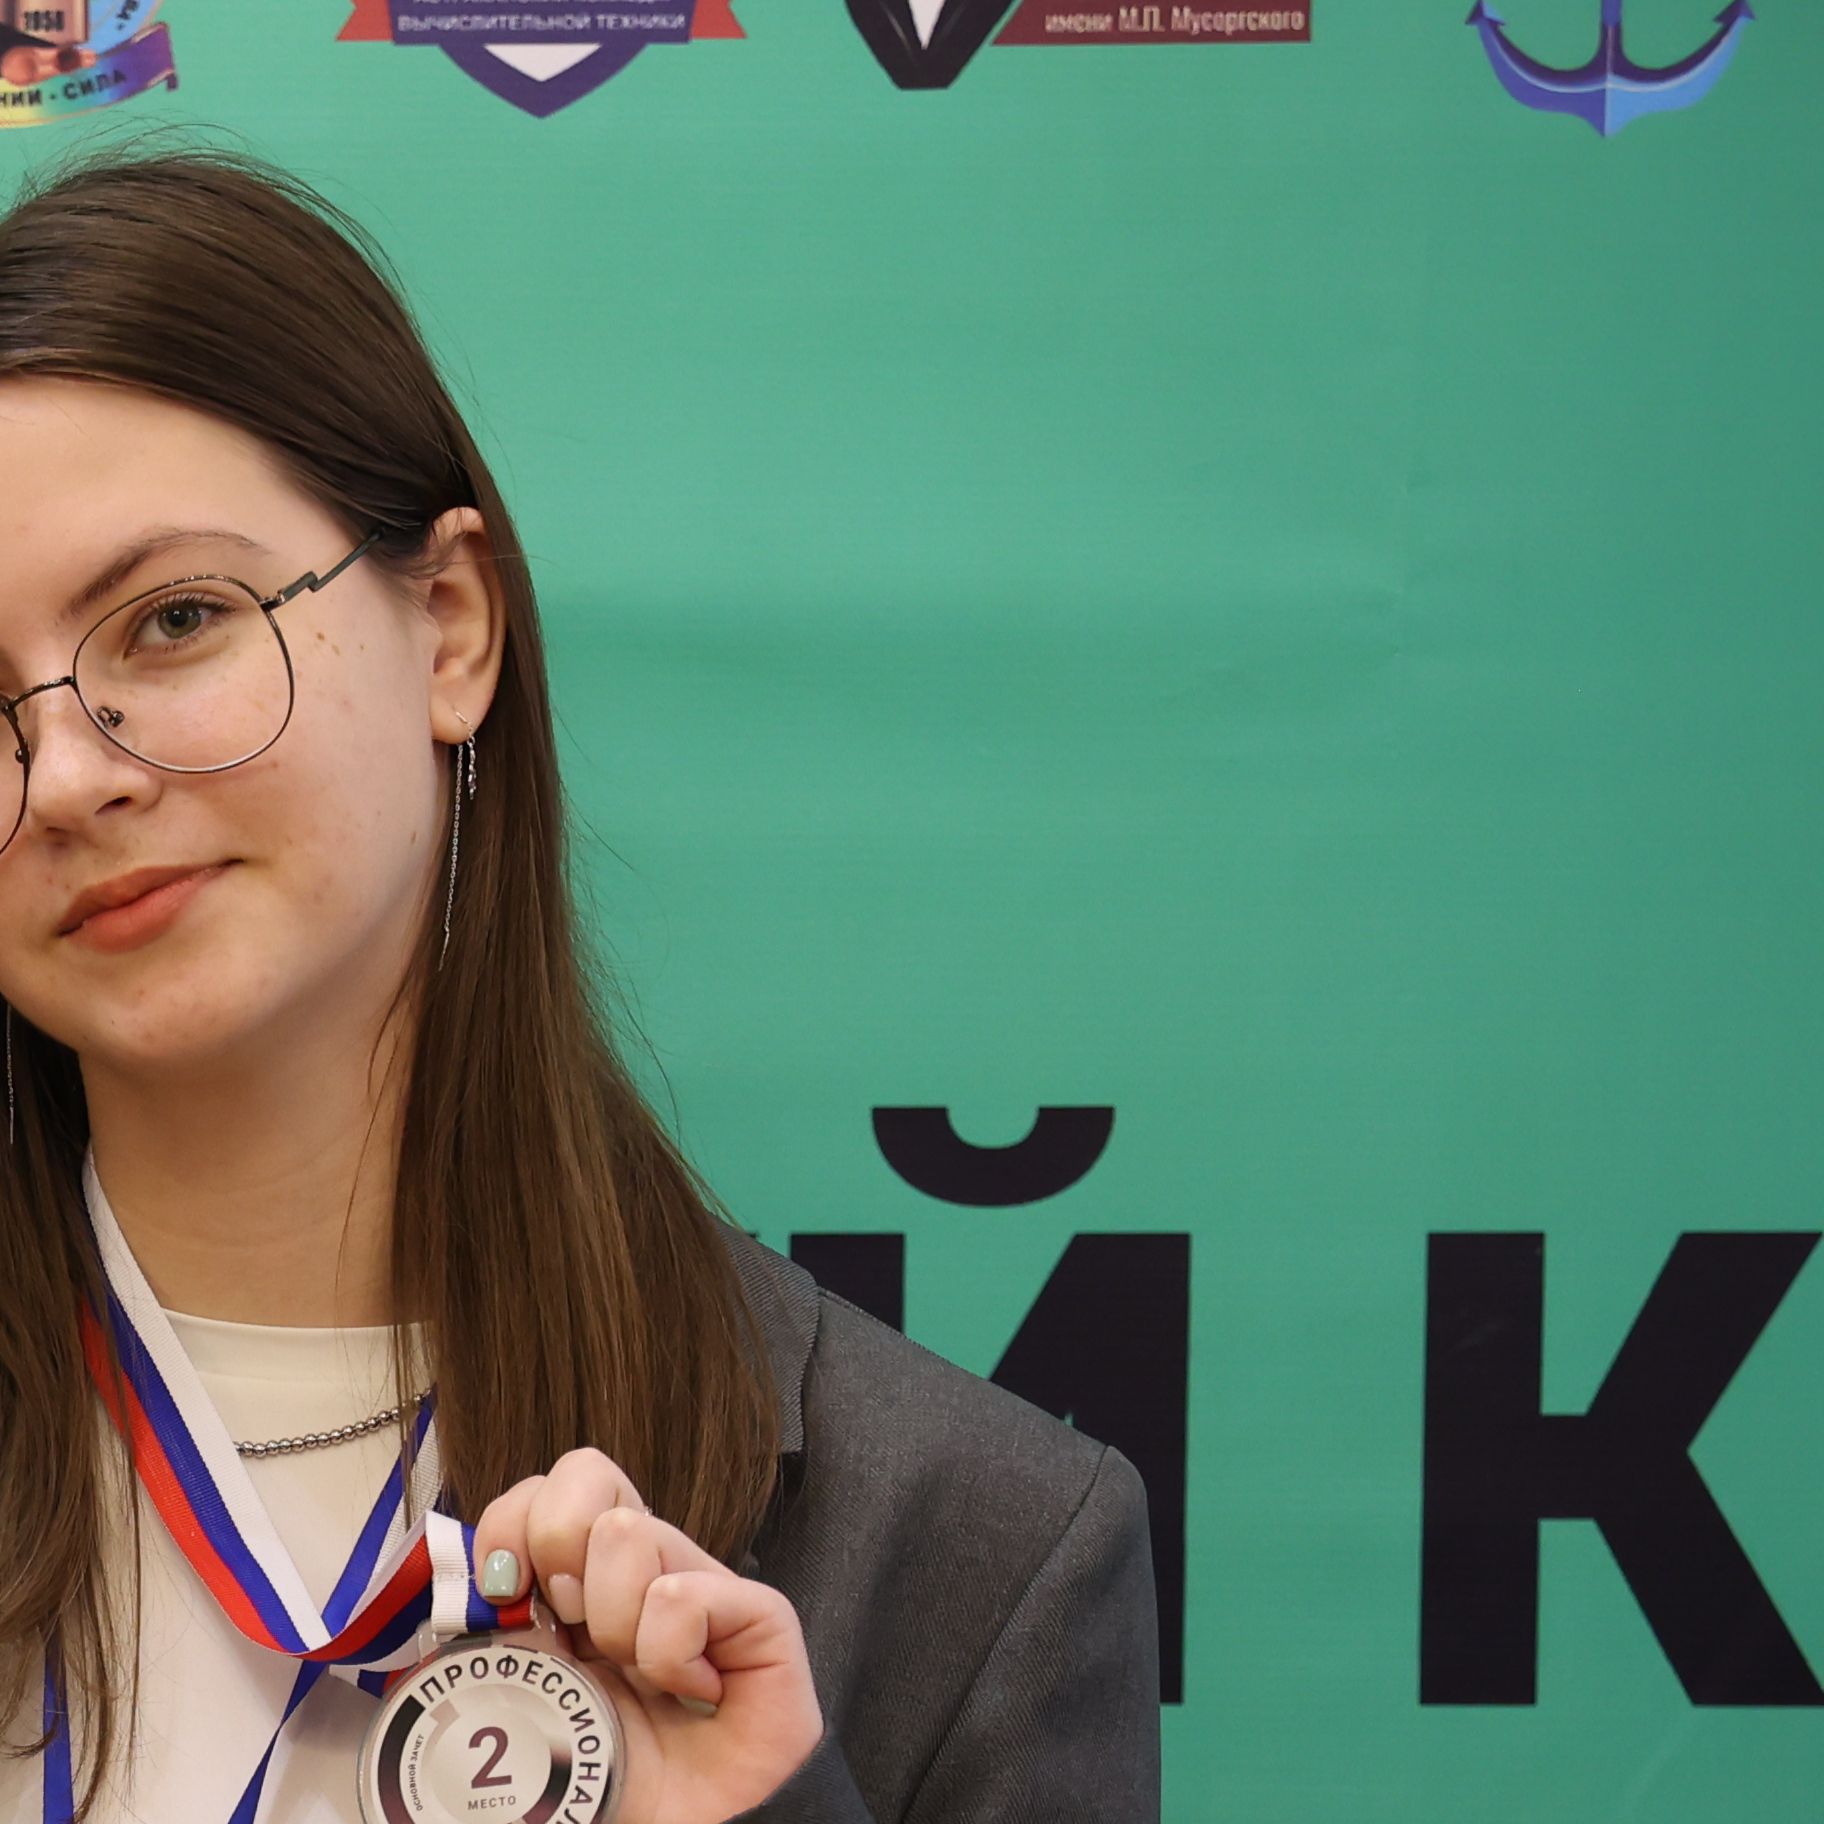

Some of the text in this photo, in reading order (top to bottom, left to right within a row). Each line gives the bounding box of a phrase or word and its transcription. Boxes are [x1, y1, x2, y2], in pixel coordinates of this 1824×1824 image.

[397, 12, 687, 32] ВЫЧИСЛИТЕЛЬНОЙ ТЕХНИКИ
[1045, 7, 1306, 35] имени М.П. Мусоргского
[63, 68, 129, 101] СИЛА
[467, 1725, 513, 1790] 2
[467, 1794, 517, 1812] МЕСТО
